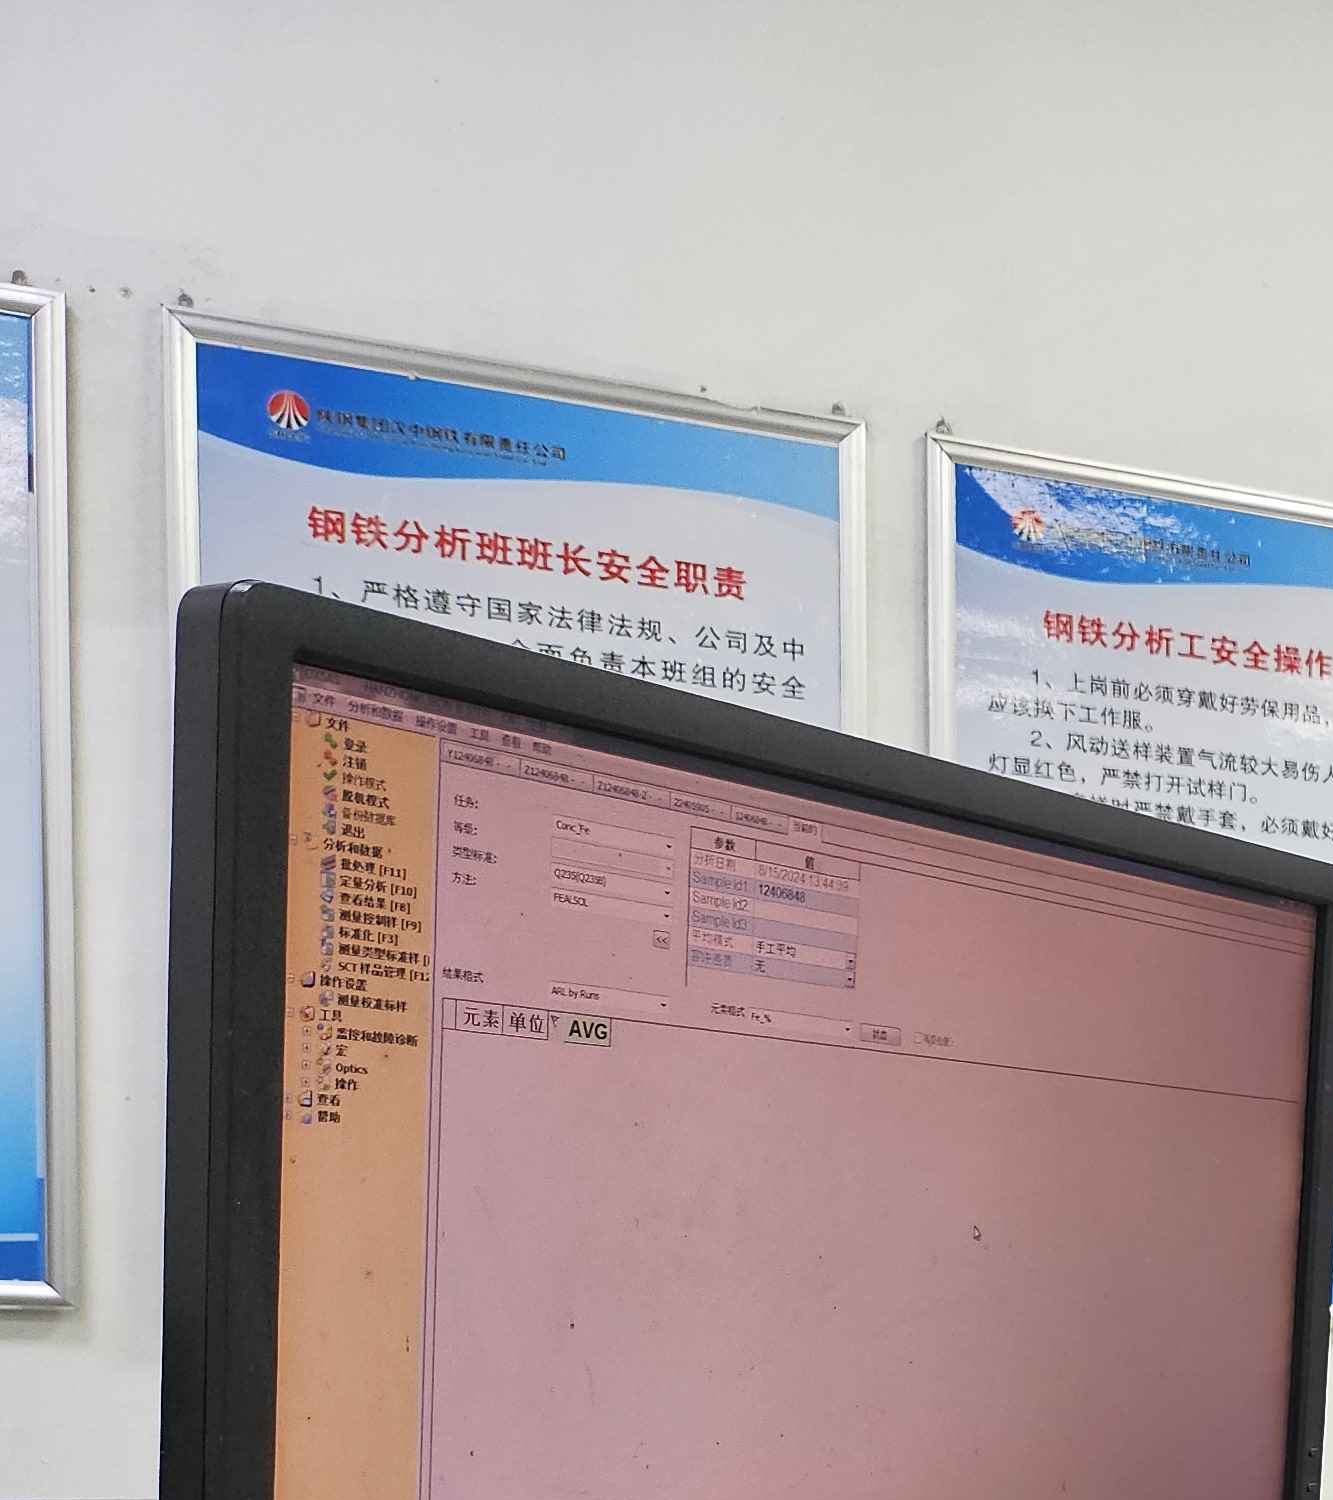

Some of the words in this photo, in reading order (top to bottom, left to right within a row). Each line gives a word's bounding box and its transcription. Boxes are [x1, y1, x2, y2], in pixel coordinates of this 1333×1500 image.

[308, 505, 748, 600] 钢铁分析班班长安全职责
[311, 575, 806, 662] 1、严格遵守国家法律法规、公司及中
[312, 692, 336, 708] 文件
[987, 693, 1156, 734] 应该换下工作服。
[326, 717, 350, 733] 文件
[343, 737, 368, 754] 登录
[988, 753, 1259, 805] 灯显红色，严禁打开试样门。
[341, 823, 365, 839] 退出
[714, 836, 736, 852] 参数
[340, 858, 375, 875] 批处理
[379, 864, 407, 880] [F11]
[340, 875, 387, 894] 定量分析
[391, 883, 417, 899] [F10]
[758, 883, 806, 903] 12406848
[340, 892, 387, 910] 查看结果
[692, 890, 732, 911] Sample
[401, 918, 422, 933] [F9]
[339, 927, 374, 942] 标准化
[378, 931, 399, 946] [F3]
[756, 940, 797, 958] 手工平均
[568, 988, 579, 1000] by
[320, 1010, 342, 1023] 工具
[463, 1007, 500, 1030] 元素
[509, 1011, 545, 1035] 单位
[568, 1020, 608, 1041] AVG
[335, 1062, 368, 1075] Optics
